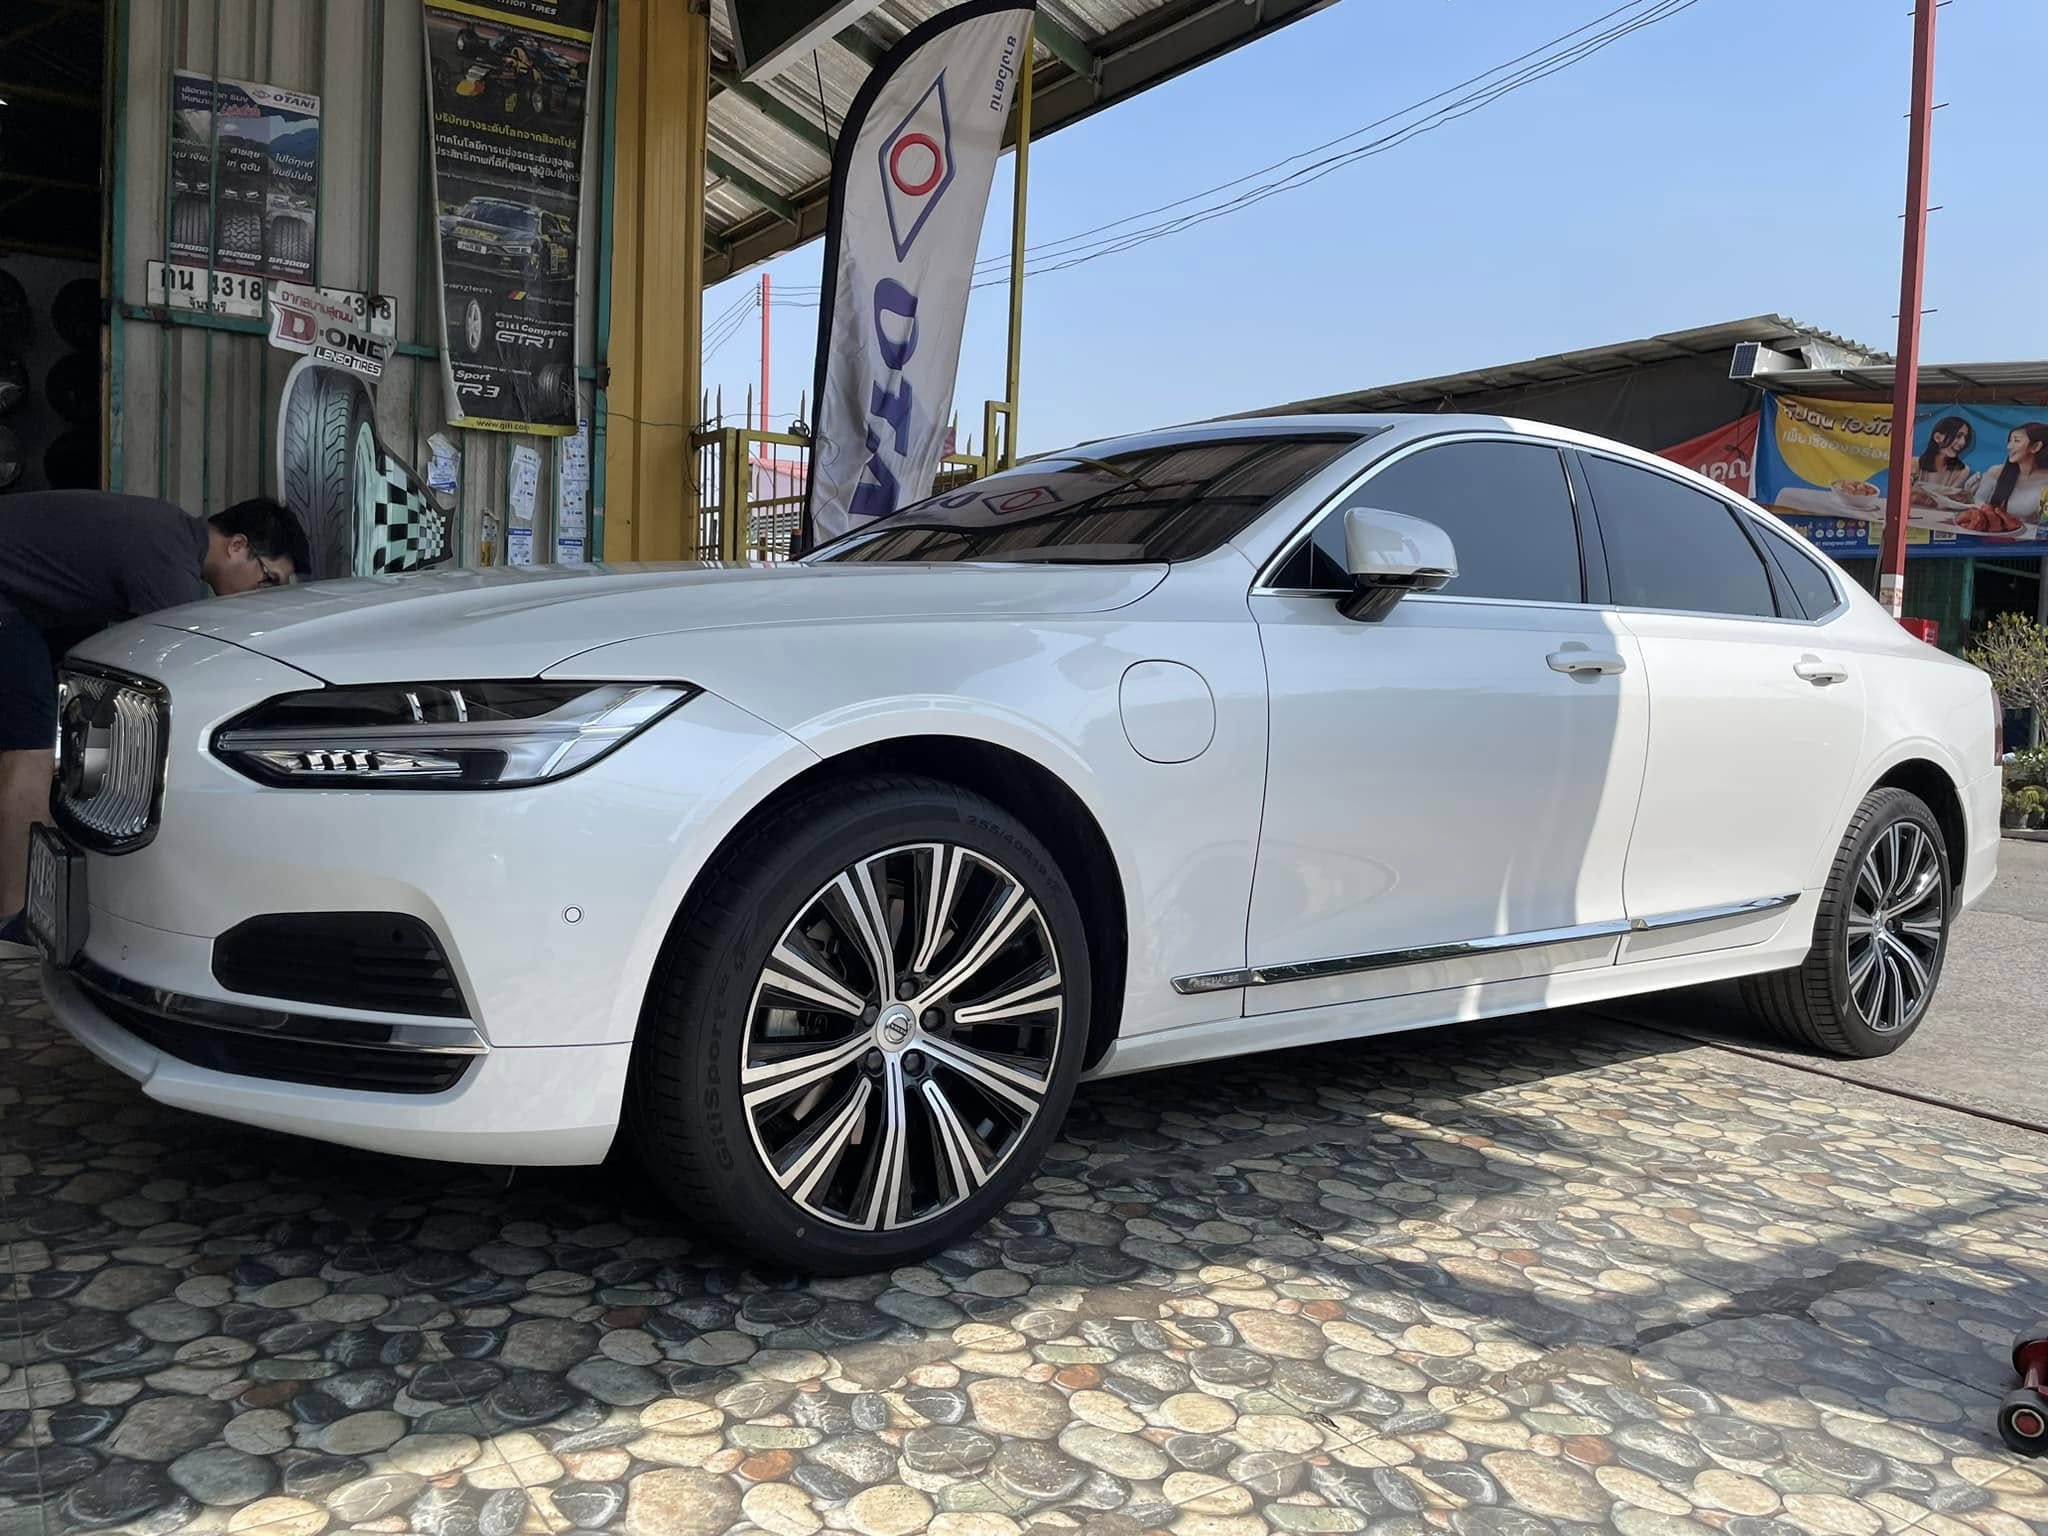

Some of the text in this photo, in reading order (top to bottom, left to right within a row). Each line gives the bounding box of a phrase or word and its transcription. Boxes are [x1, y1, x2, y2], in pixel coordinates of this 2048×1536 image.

[530, 3, 558, 16] TIRES
[273, 94, 316, 109] OTANI
[455, 369, 492, 382] Sport
